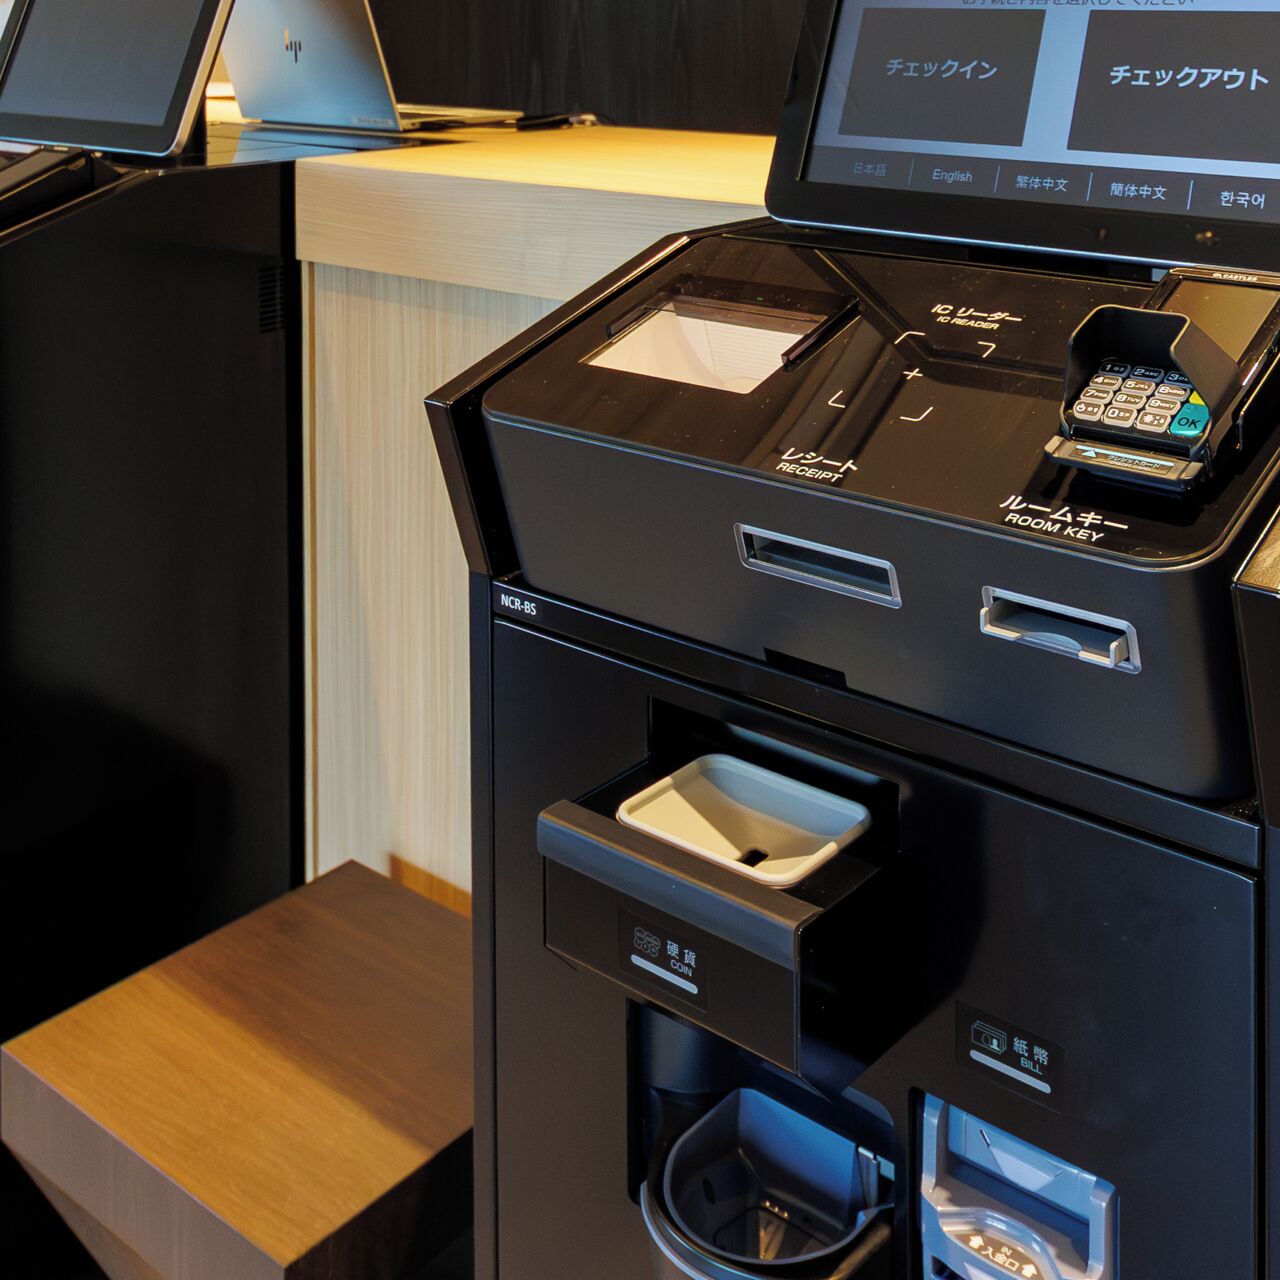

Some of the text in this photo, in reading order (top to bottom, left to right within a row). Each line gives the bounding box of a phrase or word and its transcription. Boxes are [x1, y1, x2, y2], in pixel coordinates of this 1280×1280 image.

[886, 58, 998, 80] チェックイン
[1110, 65, 1269, 91] チェックアウト
[853, 162, 888, 177] 日本語
[932, 168, 973, 184] English
[1220, 190, 1266, 210] 한국어
[931, 304, 1022, 322] IC リーダー
[950, 318, 1000, 330] READER
[1177, 417, 1201, 429] OK
[781, 447, 859, 473] レシート
[775, 462, 843, 483] RECEIPT
[999, 495, 1129, 530] ルームキー
[1004, 512, 1105, 542] ROOM KEY
[501, 593, 537, 616] NCR-BS
[670, 959, 692, 977] COIN
[1020, 1057, 1043, 1075] BILL
[980, 1246, 1020, 1271] 入金口
